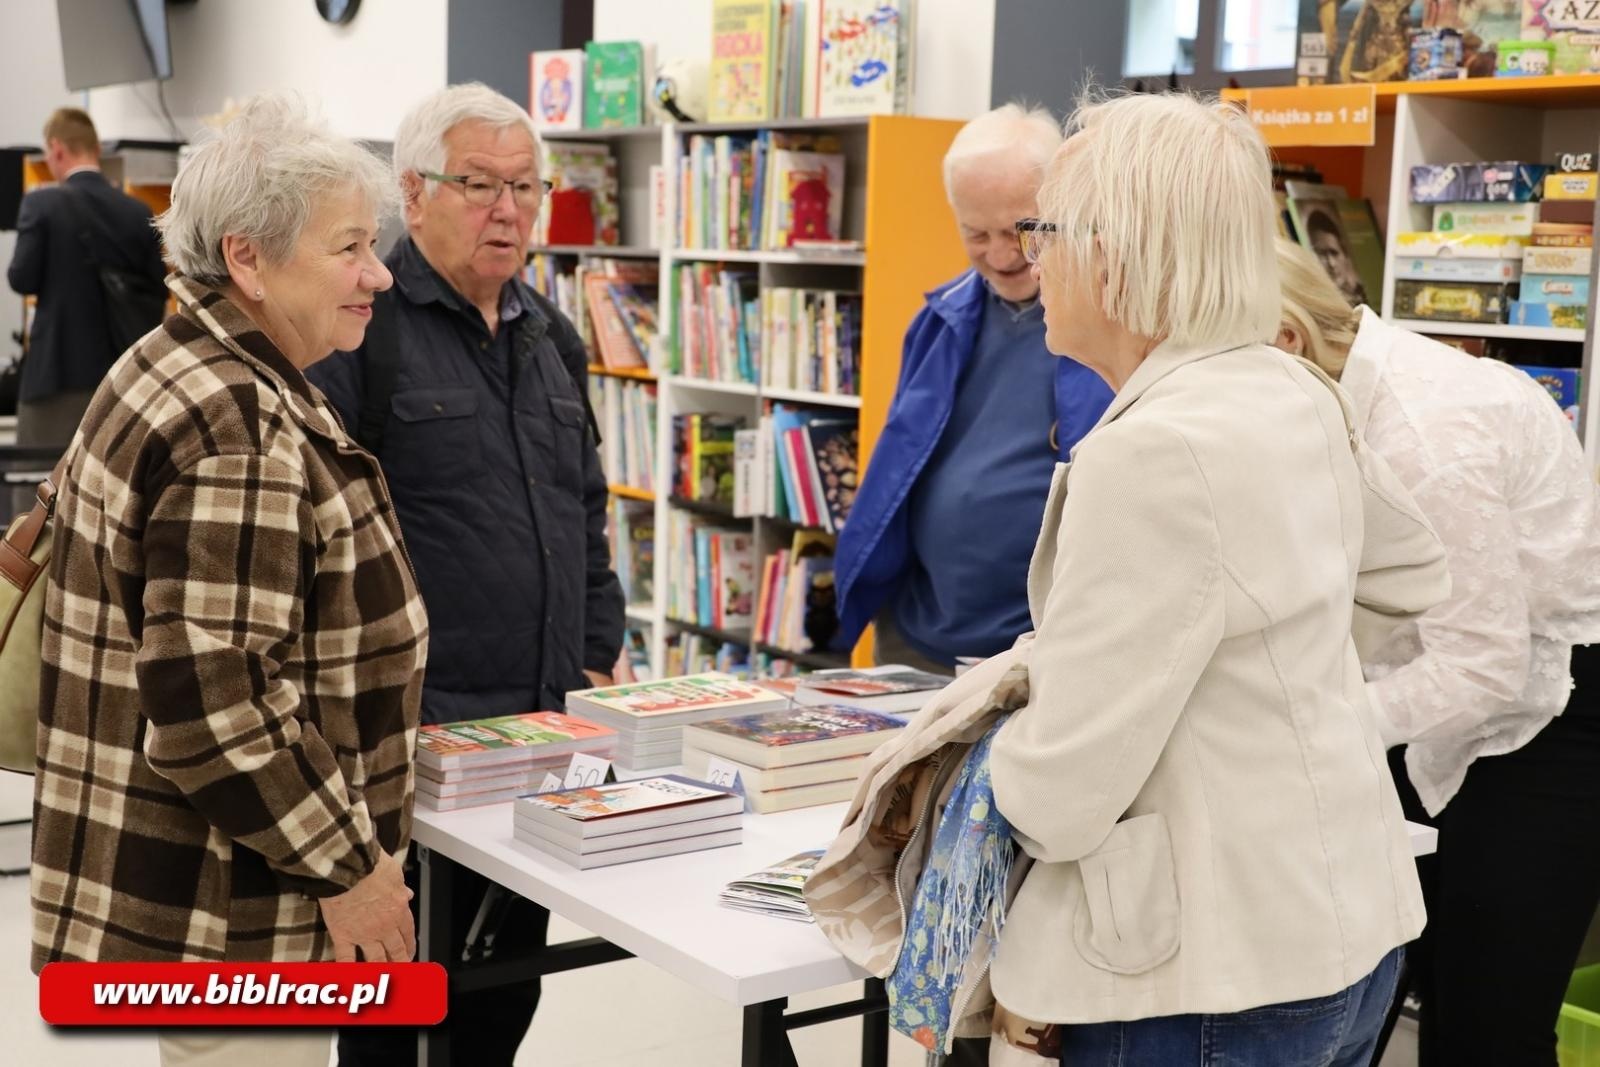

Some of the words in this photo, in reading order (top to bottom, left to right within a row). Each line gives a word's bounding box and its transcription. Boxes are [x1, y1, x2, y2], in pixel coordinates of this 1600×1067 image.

[1252, 108, 1312, 128] Książka
[1314, 111, 1334, 124] za
[1339, 107, 1347, 123] 1
[1352, 106, 1369, 124] zł
[1561, 153, 1592, 172] QUIZ
[574, 764, 600, 788] 50
